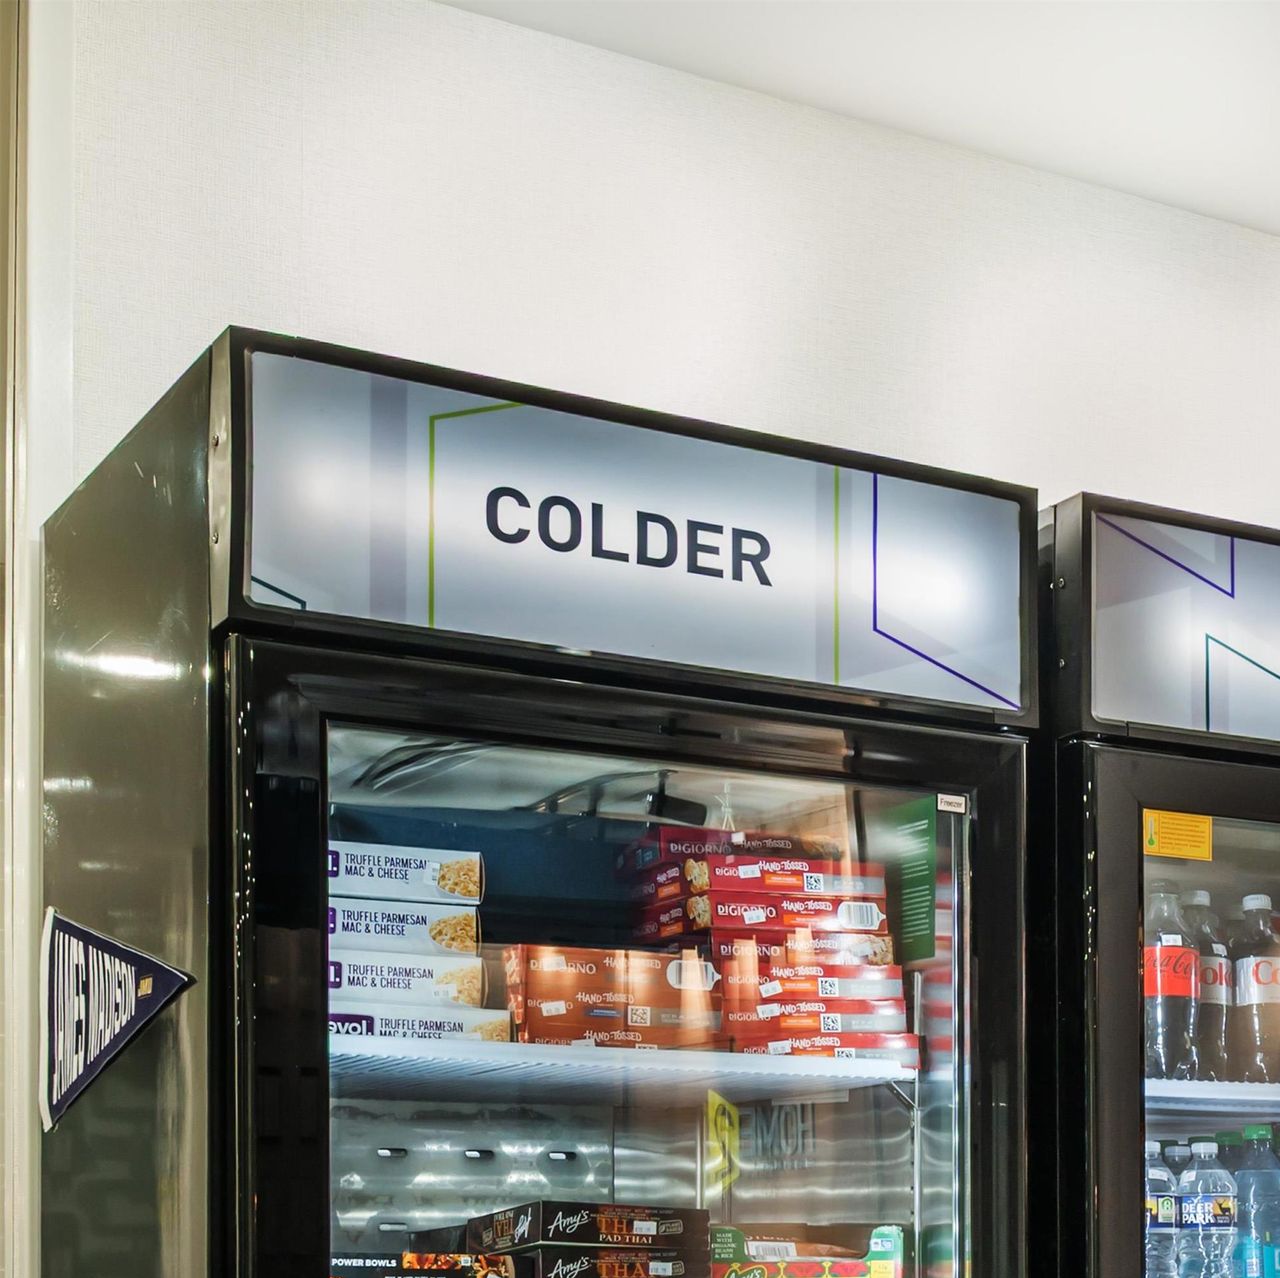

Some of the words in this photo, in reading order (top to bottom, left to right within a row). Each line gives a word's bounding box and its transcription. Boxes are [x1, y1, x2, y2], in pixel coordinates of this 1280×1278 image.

[484, 485, 773, 587] COLDER
[939, 797, 965, 810] Freezer
[342, 909, 379, 923] TRUFFLE
[381, 912, 427, 926] PARMESAN
[342, 922, 360, 934] MAC
[362, 923, 370, 934] &
[372, 925, 406, 936] CHEESE
[53, 929, 85, 1105] JAMES
[87, 945, 137, 1065] MADISON
[1182, 1201, 1213, 1214] DEER
[1182, 1211, 1216, 1225] PARK
[331, 1258, 364, 1267] POWER
[365, 1258, 396, 1268] BOWLS
